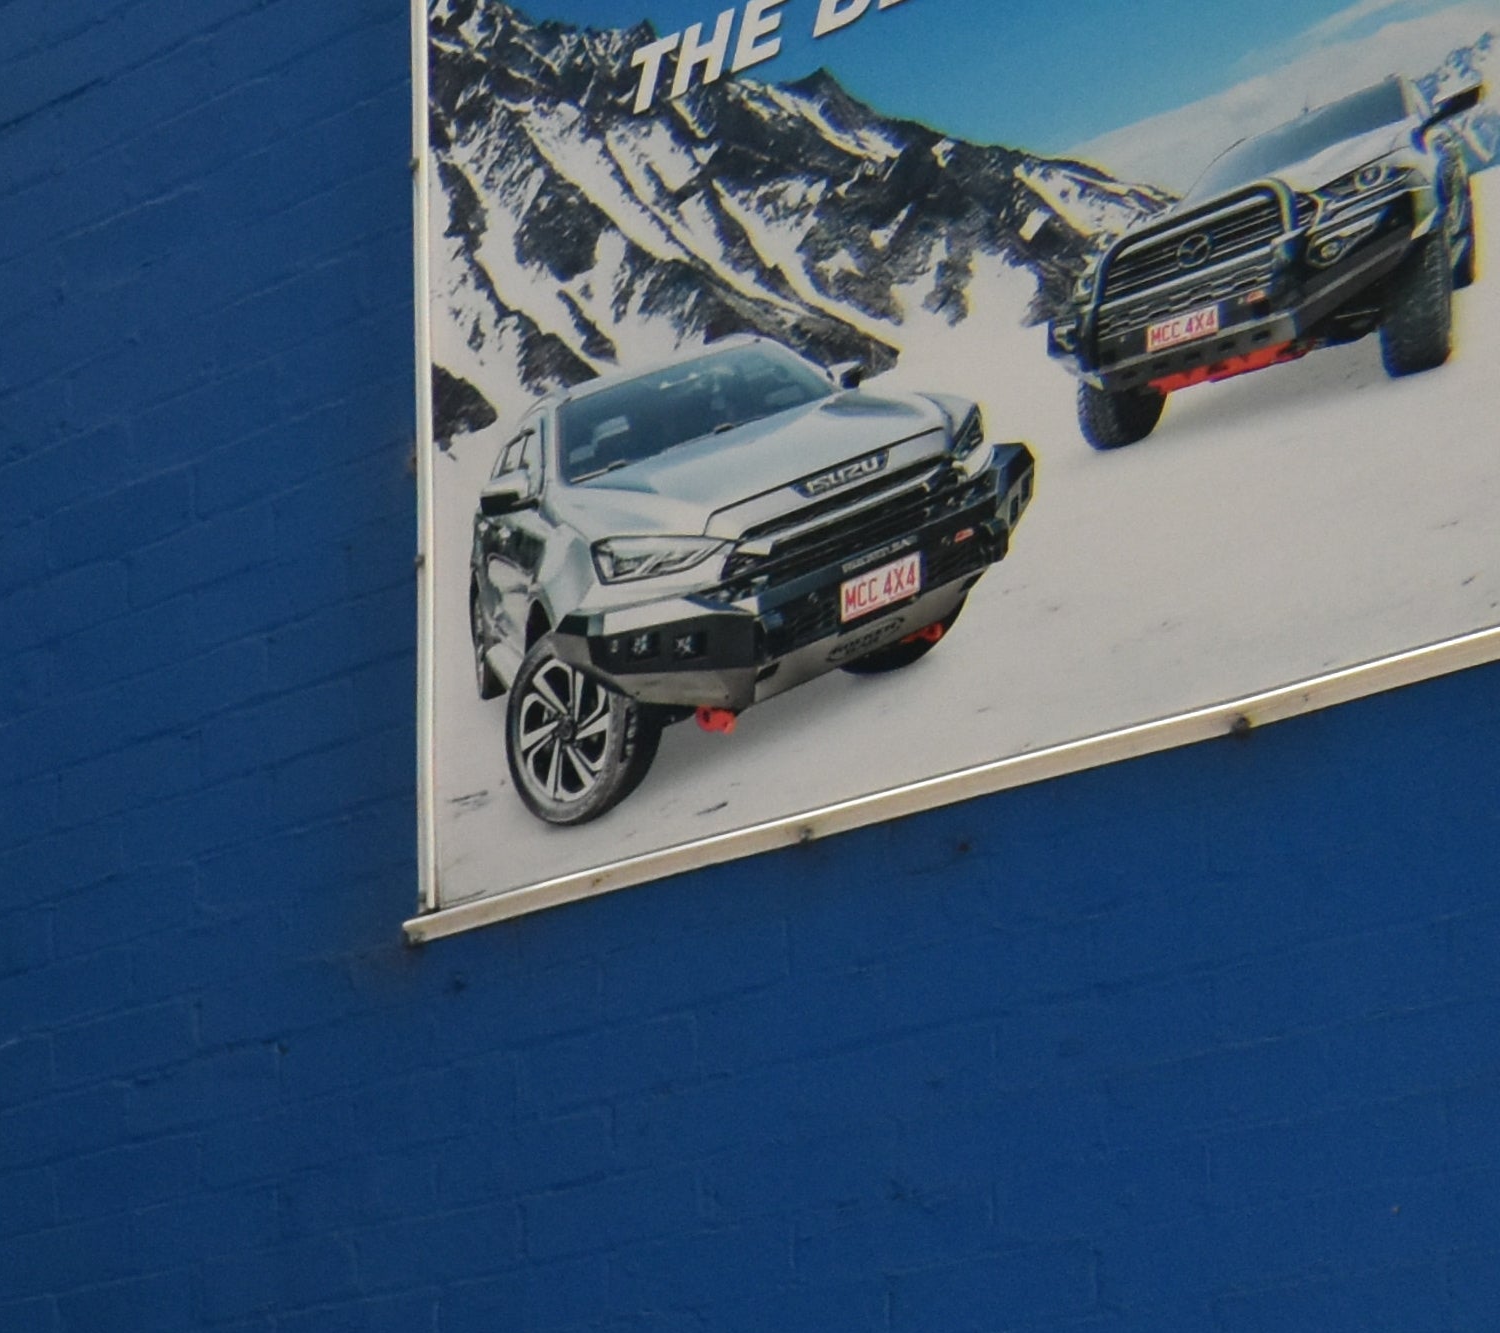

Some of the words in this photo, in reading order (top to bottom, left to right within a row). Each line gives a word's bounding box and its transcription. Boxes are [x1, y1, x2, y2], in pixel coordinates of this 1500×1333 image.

[631, 0, 783, 115] THE
[805, 456, 879, 495] ISUZU
[844, 578, 878, 613] MCC
[882, 560, 917, 596] 4X4
